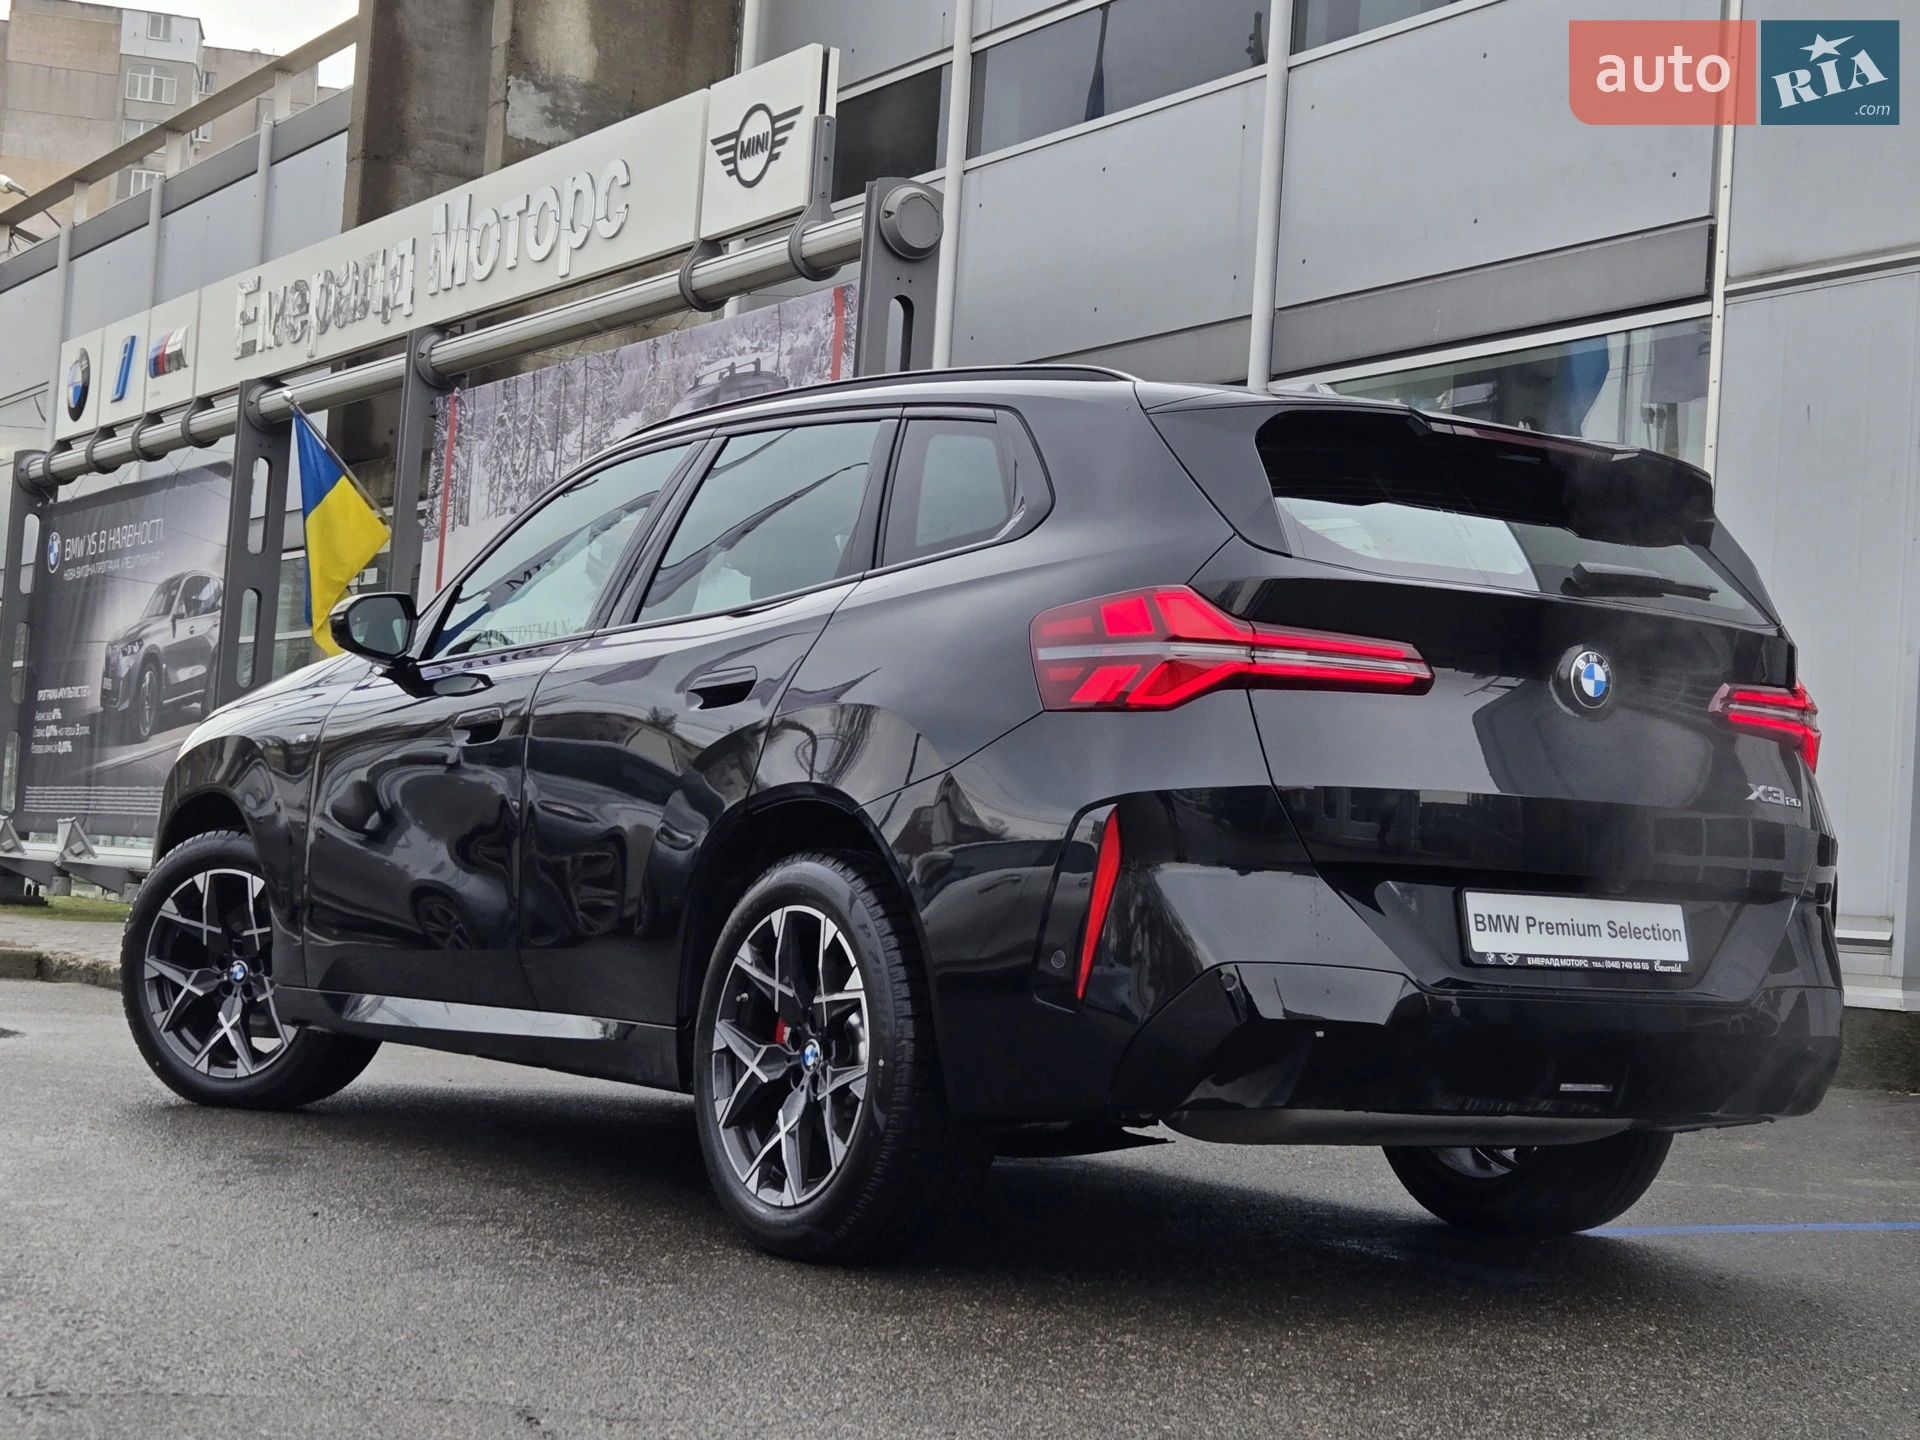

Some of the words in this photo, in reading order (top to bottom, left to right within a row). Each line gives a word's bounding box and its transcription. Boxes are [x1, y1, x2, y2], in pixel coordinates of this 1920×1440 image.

[739, 130, 770, 161] MINI
[233, 237, 416, 360] Емералд
[428, 158, 631, 296] Моторс
[64, 536, 86, 562] BMW
[1576, 653, 1611, 673] BMW
[1745, 783, 1785, 806] X3
[1473, 913, 1520, 934] BMW
[1525, 915, 1603, 938] Premium
[1607, 920, 1683, 942] Selection
[1527, 957, 1560, 967] ЕМЕРАЛД
[1560, 957, 1589, 968] МОТОРС
